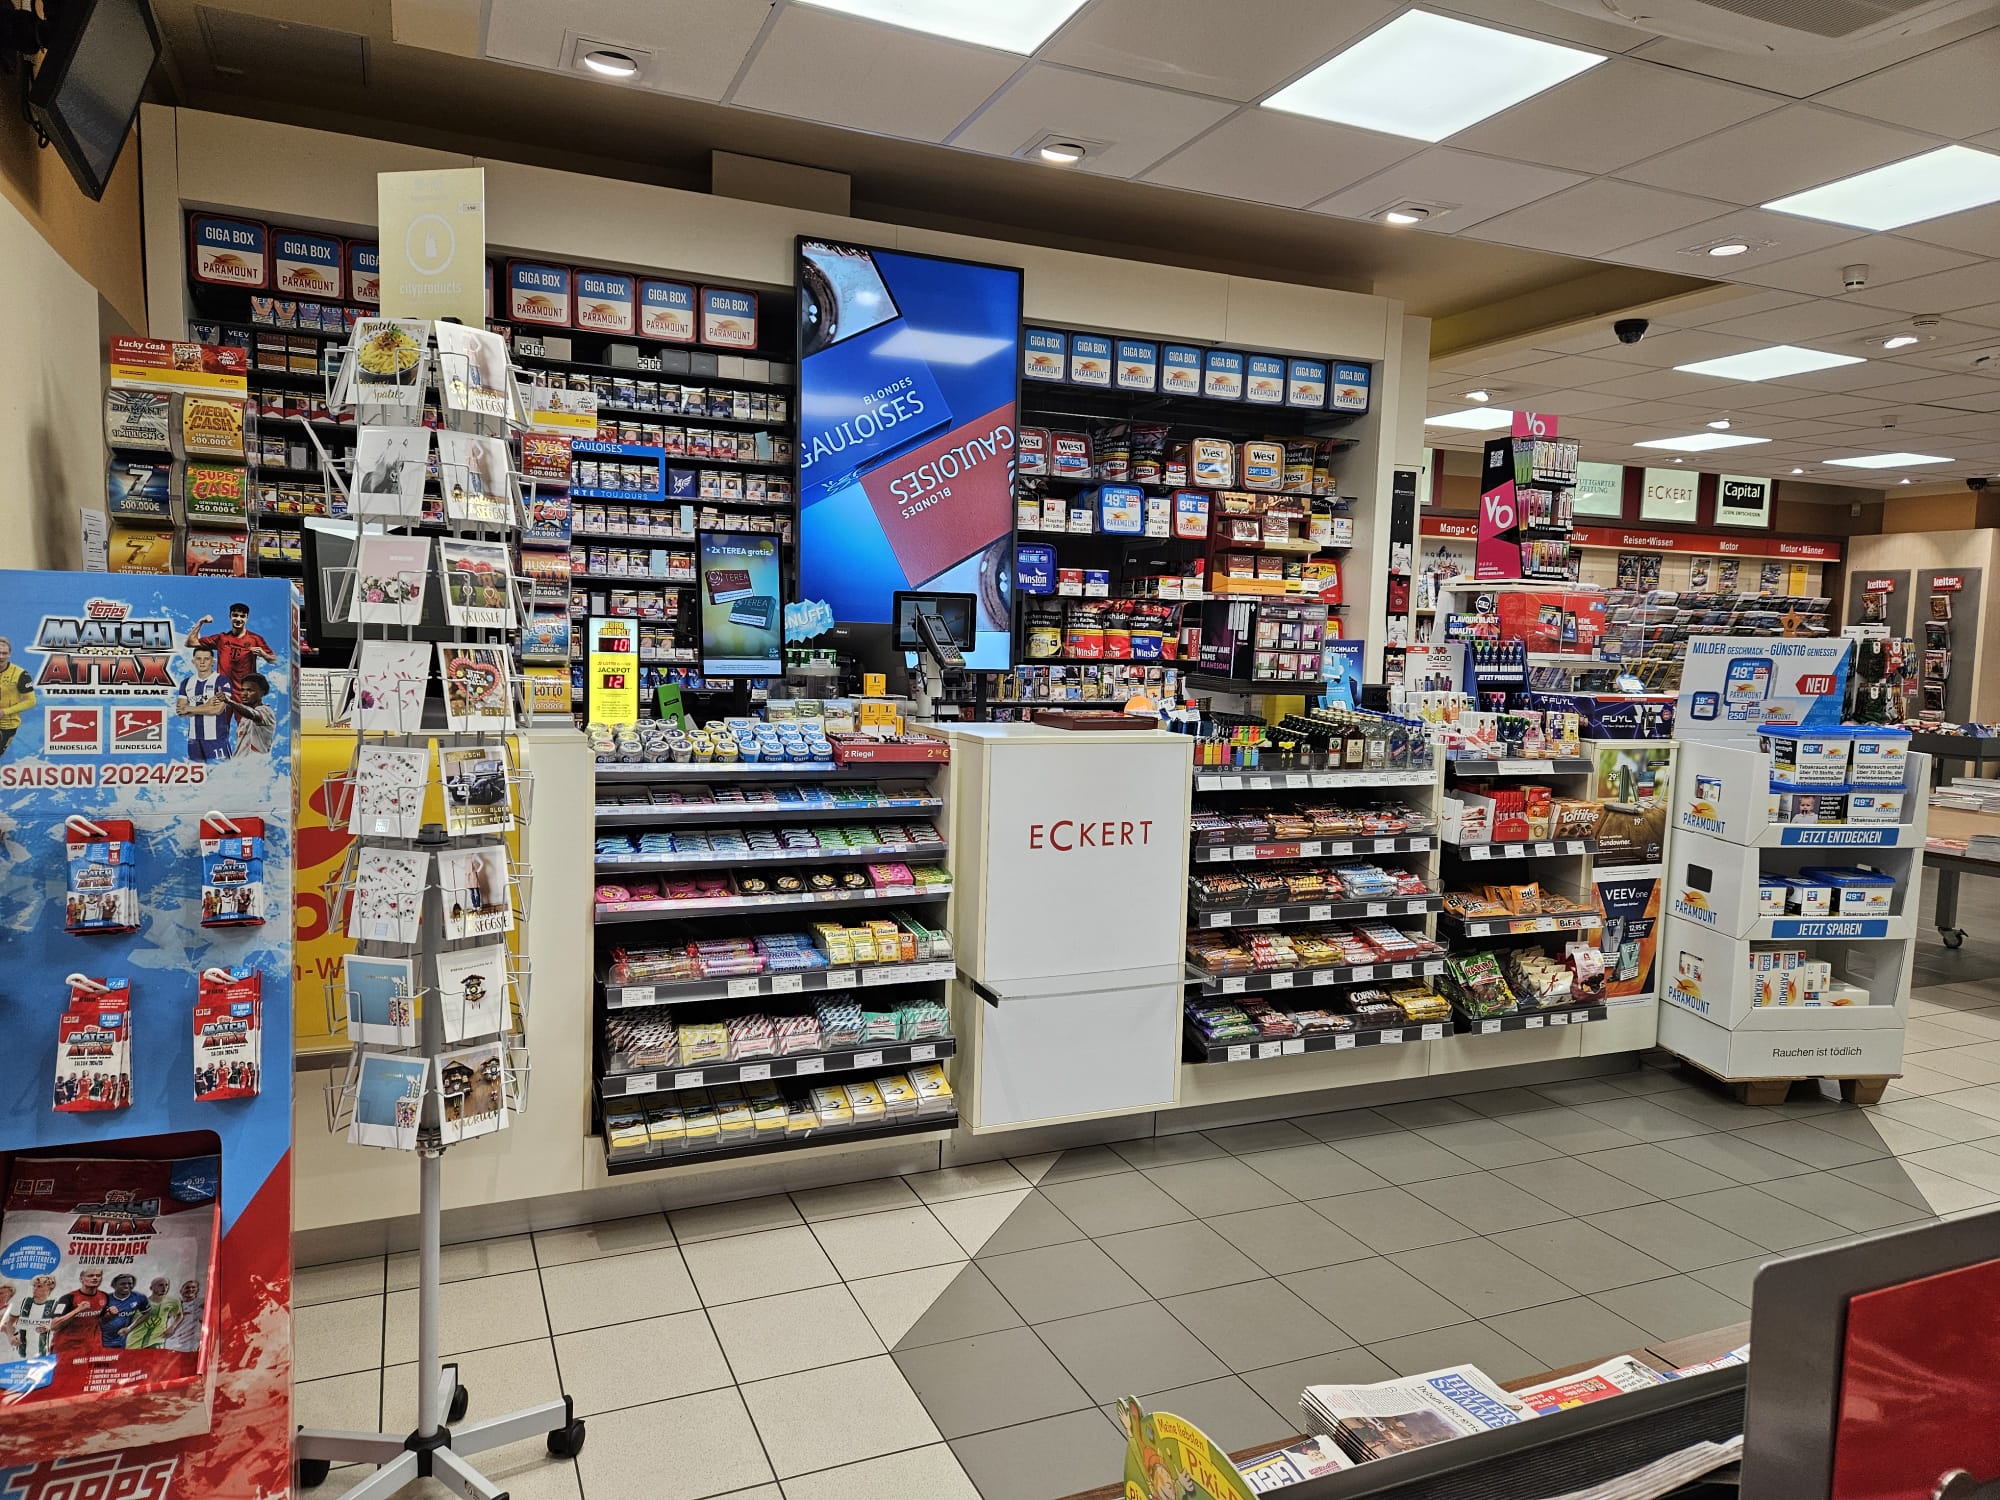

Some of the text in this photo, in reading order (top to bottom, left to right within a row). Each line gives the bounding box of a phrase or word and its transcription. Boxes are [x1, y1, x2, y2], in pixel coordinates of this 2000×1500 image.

[206, 227, 254, 246] GIGA BOX
[285, 242, 330, 259] GIGA BOX
[203, 262, 258, 279] PARAMOUNT
[282, 276, 334, 291] PARAMOUNT
[519, 271, 560, 287] GIGA BOX
[585, 280, 625, 296] GIGA BOX
[648, 288, 687, 304] GIGA BOX
[517, 303, 562, 318] PARAMOUNT
[712, 297, 748, 312] GIGA BOX
[583, 310, 627, 325] PARAMOUNT
[193, 325, 215, 333] VEEV
[646, 319, 688, 334] PARAMOUNT
[228, 330, 249, 338] VEEV
[710, 327, 751, 341] PARAMOUNT
[119, 340, 165, 350] Lucky Cash
[1030, 336, 1060, 349] GIGA BOX
[1078, 341, 1106, 354] GIGA BOX
[519, 343, 545, 356] 49.00
[1123, 347, 1151, 359] GIGA BOX
[1169, 352, 1196, 363] GIGA BOX
[1211, 357, 1238, 368] GIGA BOX
[1028, 363, 1061, 376] PARAMOUNT
[1074, 368, 1107, 380] PARAMOUNT
[1253, 362, 1280, 374] GIGA BOX
[1296, 367, 1321, 378] GIGA BOX
[1121, 373, 1152, 385] PARAMOUNT
[1340, 370, 1365, 382] GIGA BOX
[1166, 378, 1197, 389] PARAMOUNT
[1208, 382, 1239, 393] PARAMOUNT
[863, 377, 913, 405] BLONDES
[1250, 387, 1280, 398] PARAMOUNT
[1293, 391, 1322, 402] PARAMOUNT
[1337, 394, 1365, 406] PARAMOUNT
[189, 405, 235, 423] MEGA
[191, 417, 233, 431] CASH
[571, 441, 622, 453] GAULOISES
[1058, 442, 1083, 452] West
[1202, 448, 1224, 458] West
[1253, 452, 1275, 461] West
[890, 425, 1015, 504] GAULOISES
[197, 470, 239, 482] SUPER
[1576, 478, 1616, 489] TUTTGARTER
[1578, 486, 1608, 494] ZEITUNG
[1648, 485, 1692, 500] ECKERT
[1724, 482, 1760, 500] Capital
[195, 504, 228, 512] 250.000
[902, 487, 952, 520] BLONDES
[1440, 523, 1465, 535] Manga
[1624, 536, 1674, 547] Reisen Wissen
[1720, 541, 1739, 551] Motor
[1780, 544, 1824, 555] Motor Männer
[725, 574, 748, 582] TEREA
[1019, 573, 1047, 584] Winston
[1450, 616, 1477, 624] FLAVOUR
[40, 620, 172, 649] MATCH
[1450, 627, 1476, 635] QUALITY
[614, 639, 628, 651] 10
[1693, 642, 1838, 657] MILDER GESCHMACK GÜNSTIG GENIESSEN
[37, 655, 176, 686] ATTAX
[608, 675, 623, 688] 12
[1806, 678, 1829, 693] NEU
[134, 688, 168, 696] GAME
[1730, 691, 1762, 699] PARAMOUNT
[1602, 715, 1632, 723] FUYL
[147, 727, 160, 740] 2
[851, 750, 874, 759] Riegel
[2, 765, 205, 786] SAISON 2024/25
[1561, 809, 1599, 823] Toffifee
[1683, 814, 1725, 835] PARAMOUNT
[1030, 820, 1153, 851] ECKERT
[1798, 830, 1882, 844] JETZT ENTDECKEN
[1605, 887, 1636, 900] VEEV
[1675, 901, 1717, 925] PARAMOUNT
[1797, 923, 1862, 936] JETZT SPAREN
[1465, 960, 1494, 976] HARIBO
[1351, 990, 1380, 1002] CORNY
[1668, 987, 1710, 1015] PARAMOUNT
[203, 1022, 246, 1033] MATCH
[68, 1033, 114, 1042] MATCH
[1772, 1047, 1862, 1057] Rauchen ist tödlich
[68, 1215, 158, 1235] ATTAX
[69, 1241, 148, 1256] STARTERPACK
[79, 1256, 134, 1264] SAISON 2024/25
[1157, 1418, 1204, 1449] Meine liebsten
